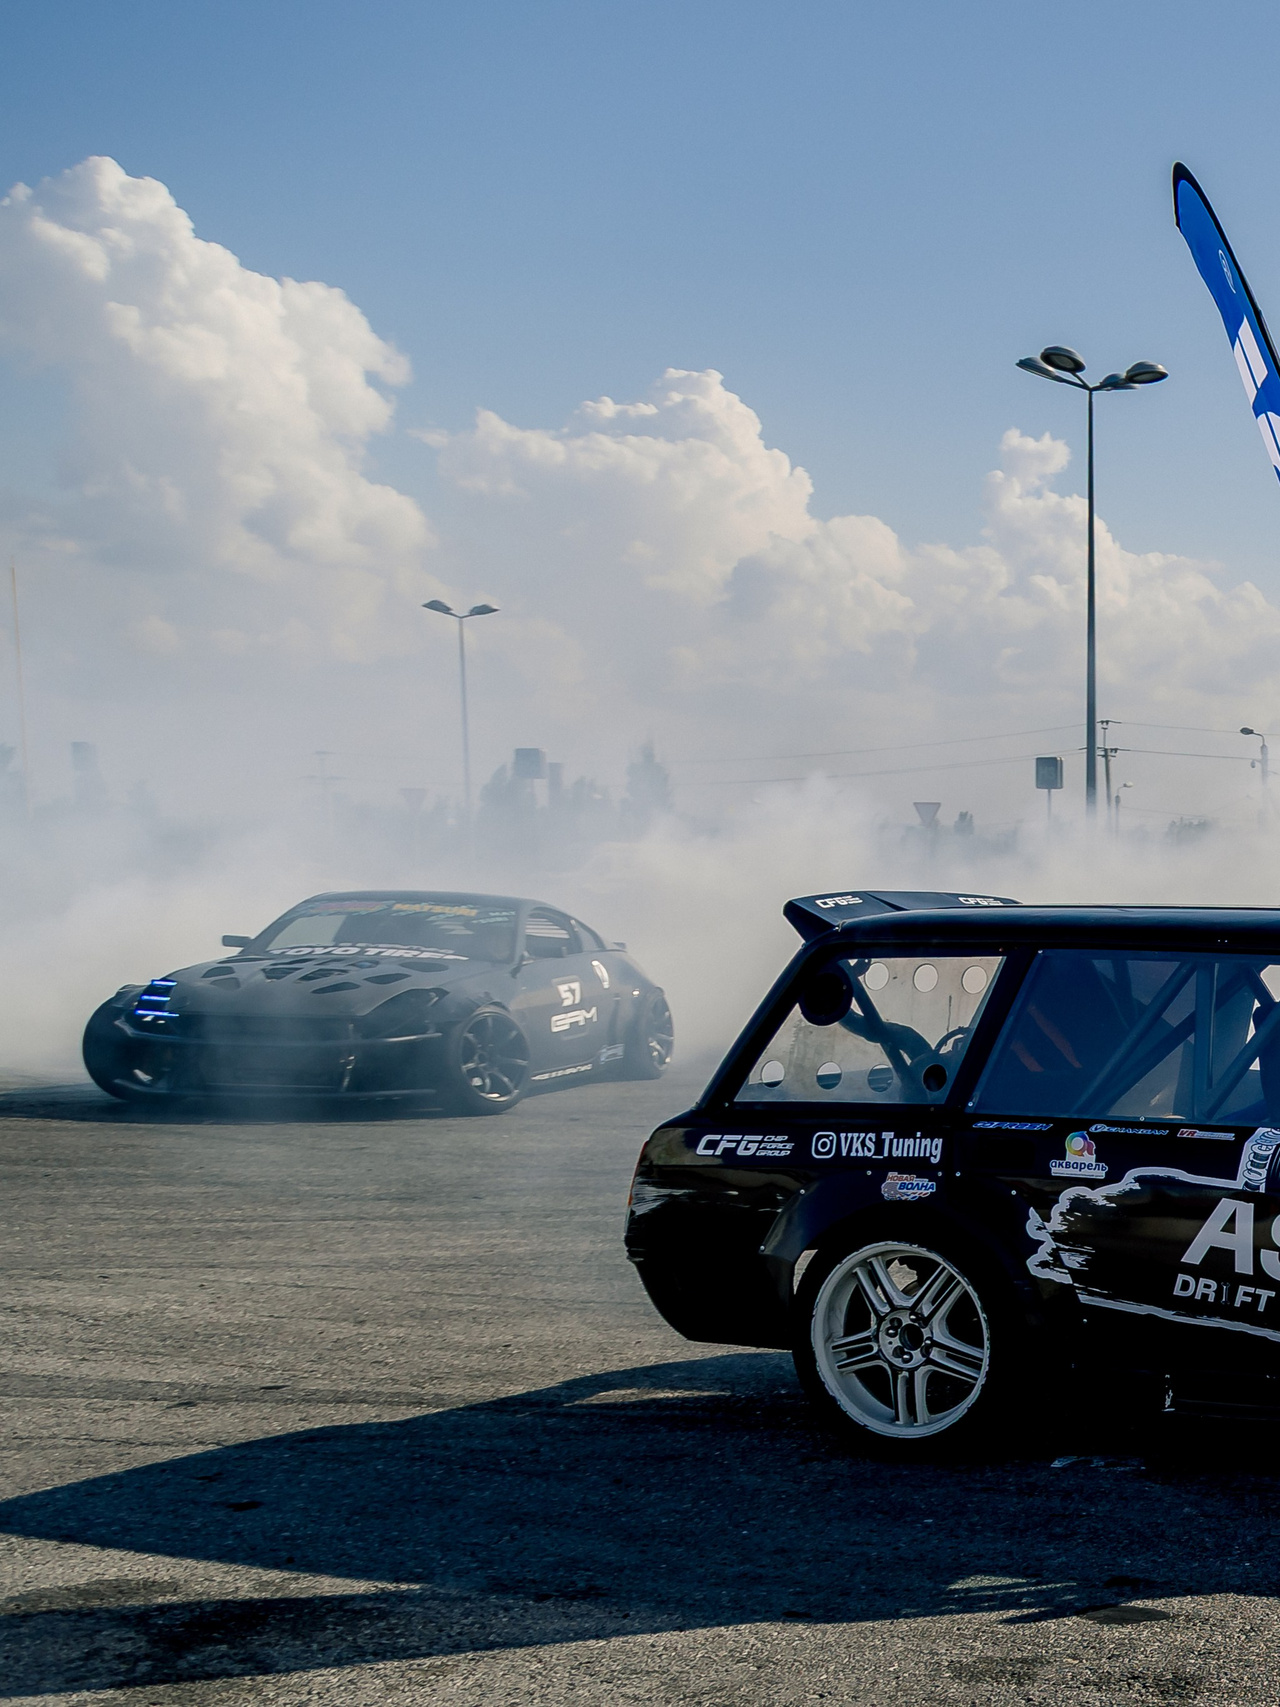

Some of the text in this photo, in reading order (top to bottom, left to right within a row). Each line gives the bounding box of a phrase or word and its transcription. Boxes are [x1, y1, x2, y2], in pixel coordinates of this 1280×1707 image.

[557, 981, 581, 1007] 57
[696, 1134, 763, 1156] CFG
[840, 1132, 943, 1163] VKS_Tuning
[1050, 1160, 1108, 1172] акварель
[898, 1182, 935, 1191] ВОЛНА
